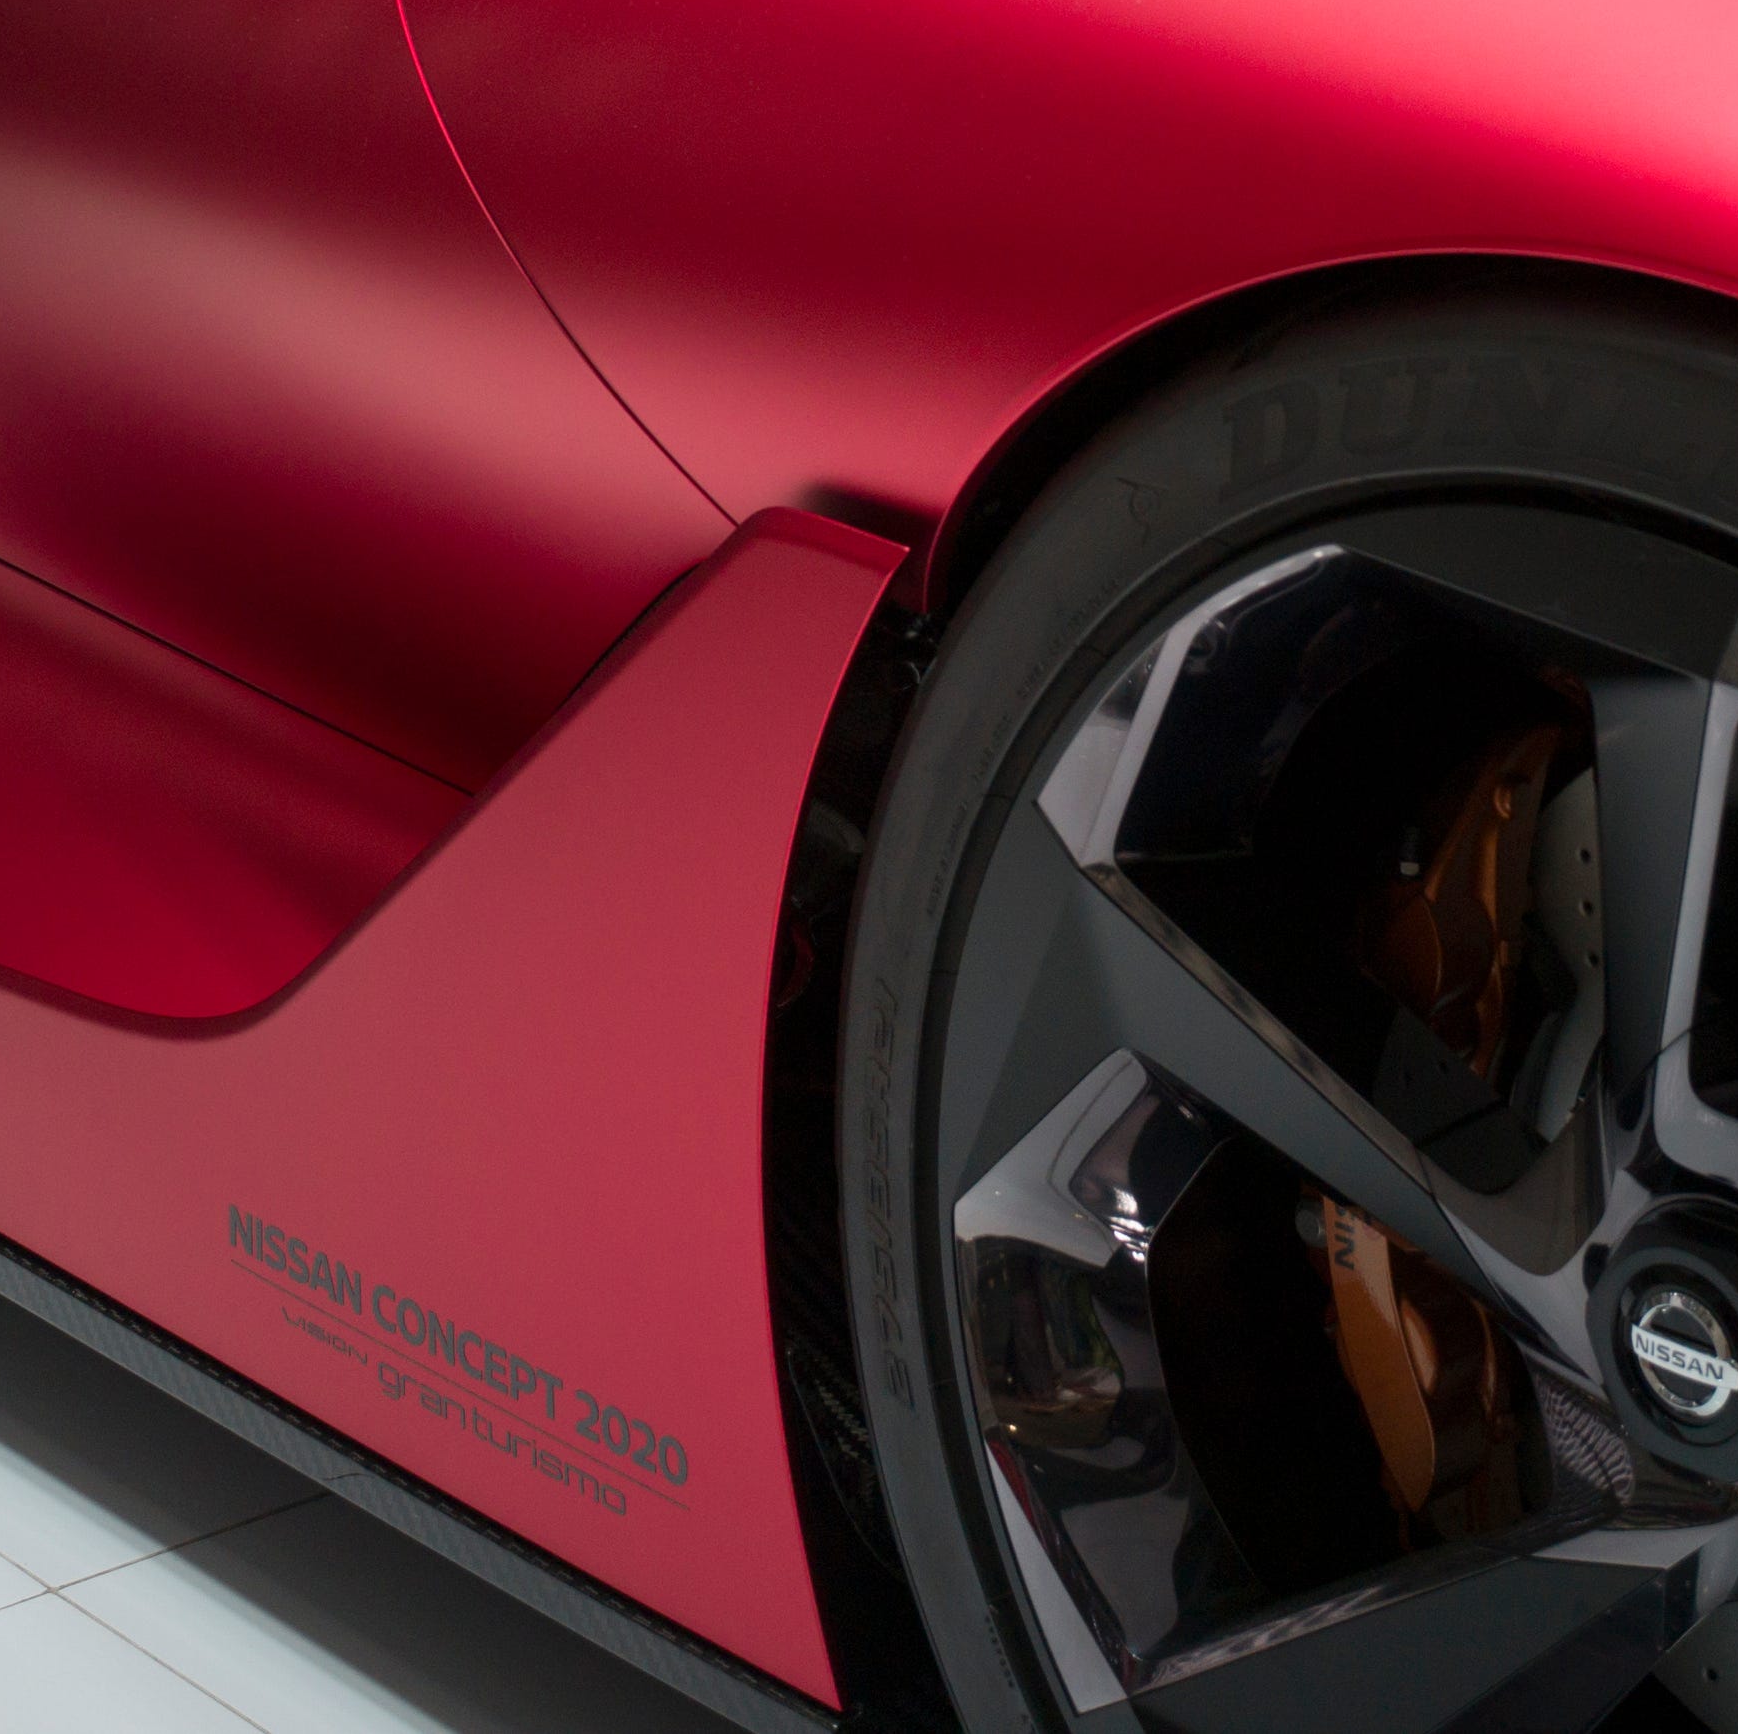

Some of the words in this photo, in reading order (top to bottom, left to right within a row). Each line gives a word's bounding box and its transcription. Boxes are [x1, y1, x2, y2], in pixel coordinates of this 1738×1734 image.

[228, 1203, 363, 1316] NISSAN
[371, 1284, 564, 1421] CONCEPT
[574, 1389, 688, 1487] 2020
[1636, 1333, 1724, 1381] NISSAN
